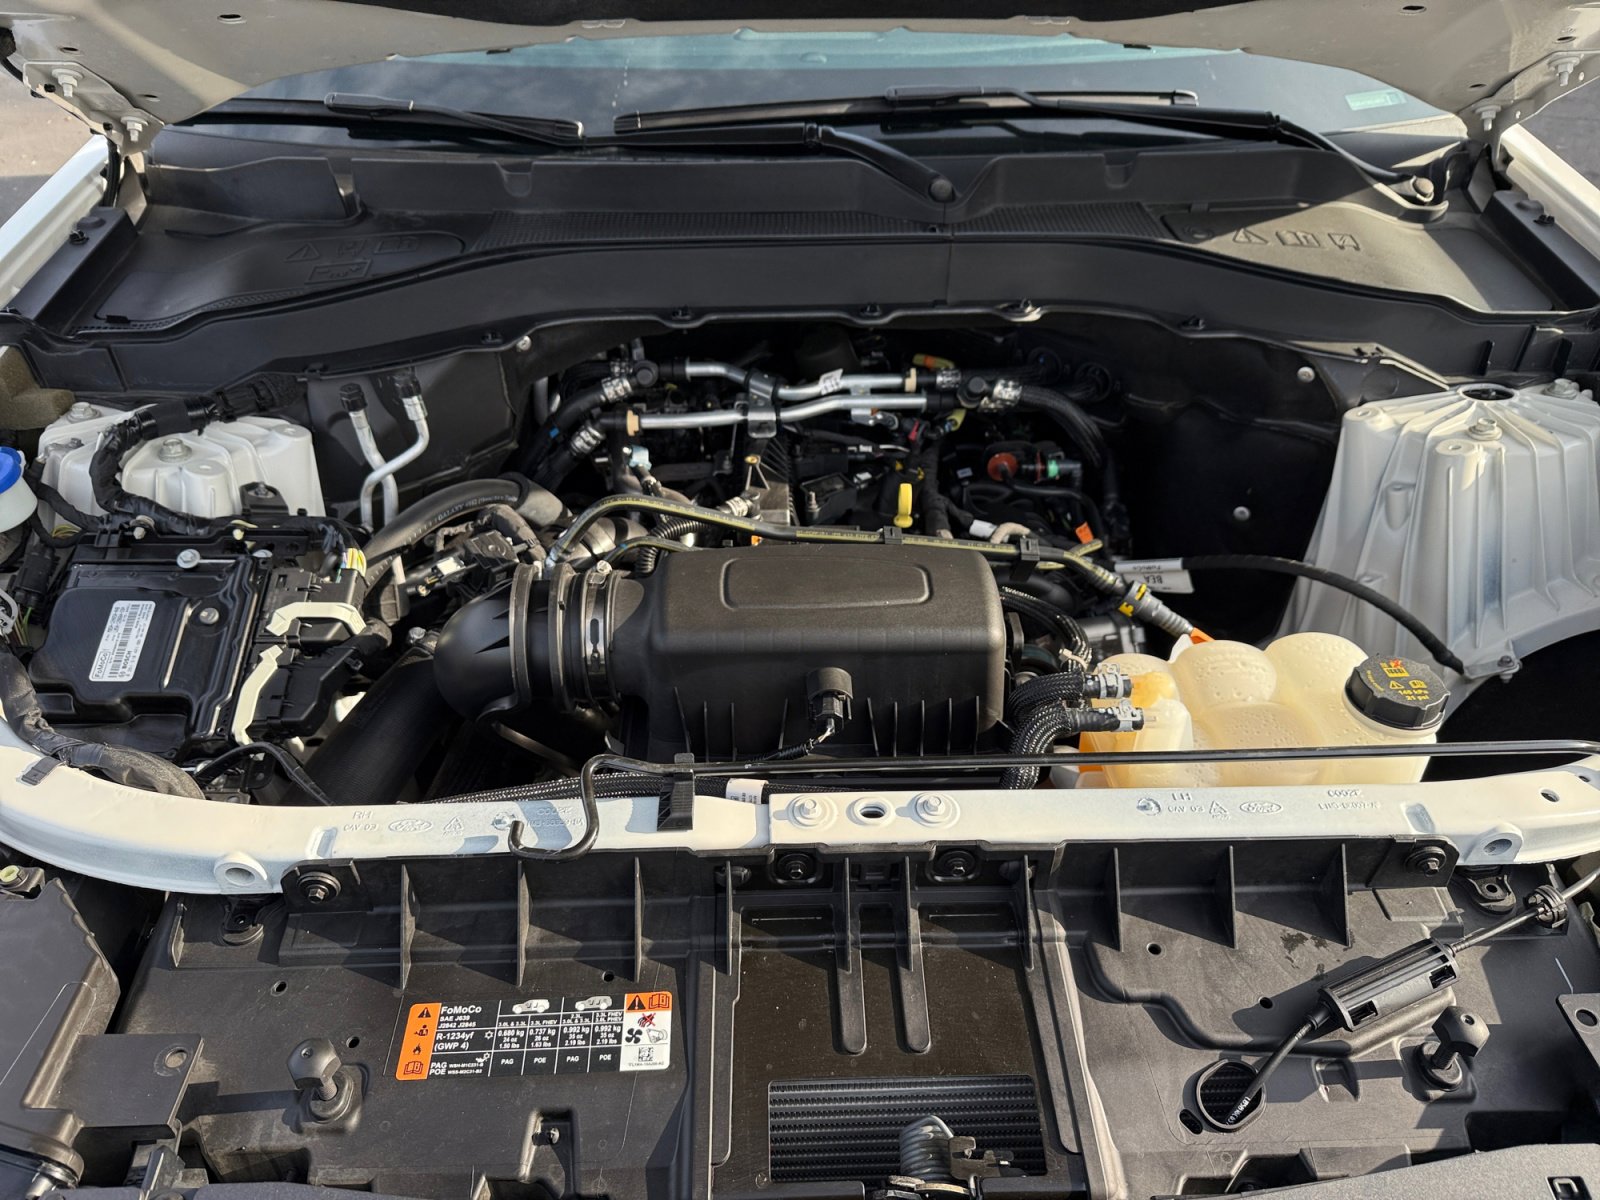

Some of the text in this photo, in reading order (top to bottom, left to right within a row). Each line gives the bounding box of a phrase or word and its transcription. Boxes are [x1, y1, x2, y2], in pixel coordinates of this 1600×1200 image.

[122, 650, 132, 669] BOSCH
[95, 652, 108, 678] FoMoCo
[440, 1005, 482, 1014] FoMoCo
[516, 1029, 525, 1037] kg
[548, 1028, 556, 1036] kg
[581, 1026, 590, 1034] kg
[612, 1025, 621, 1033] kg
[436, 1031, 475, 1041] R-1234yf
[434, 1041, 470, 1052] (GWP 4)
